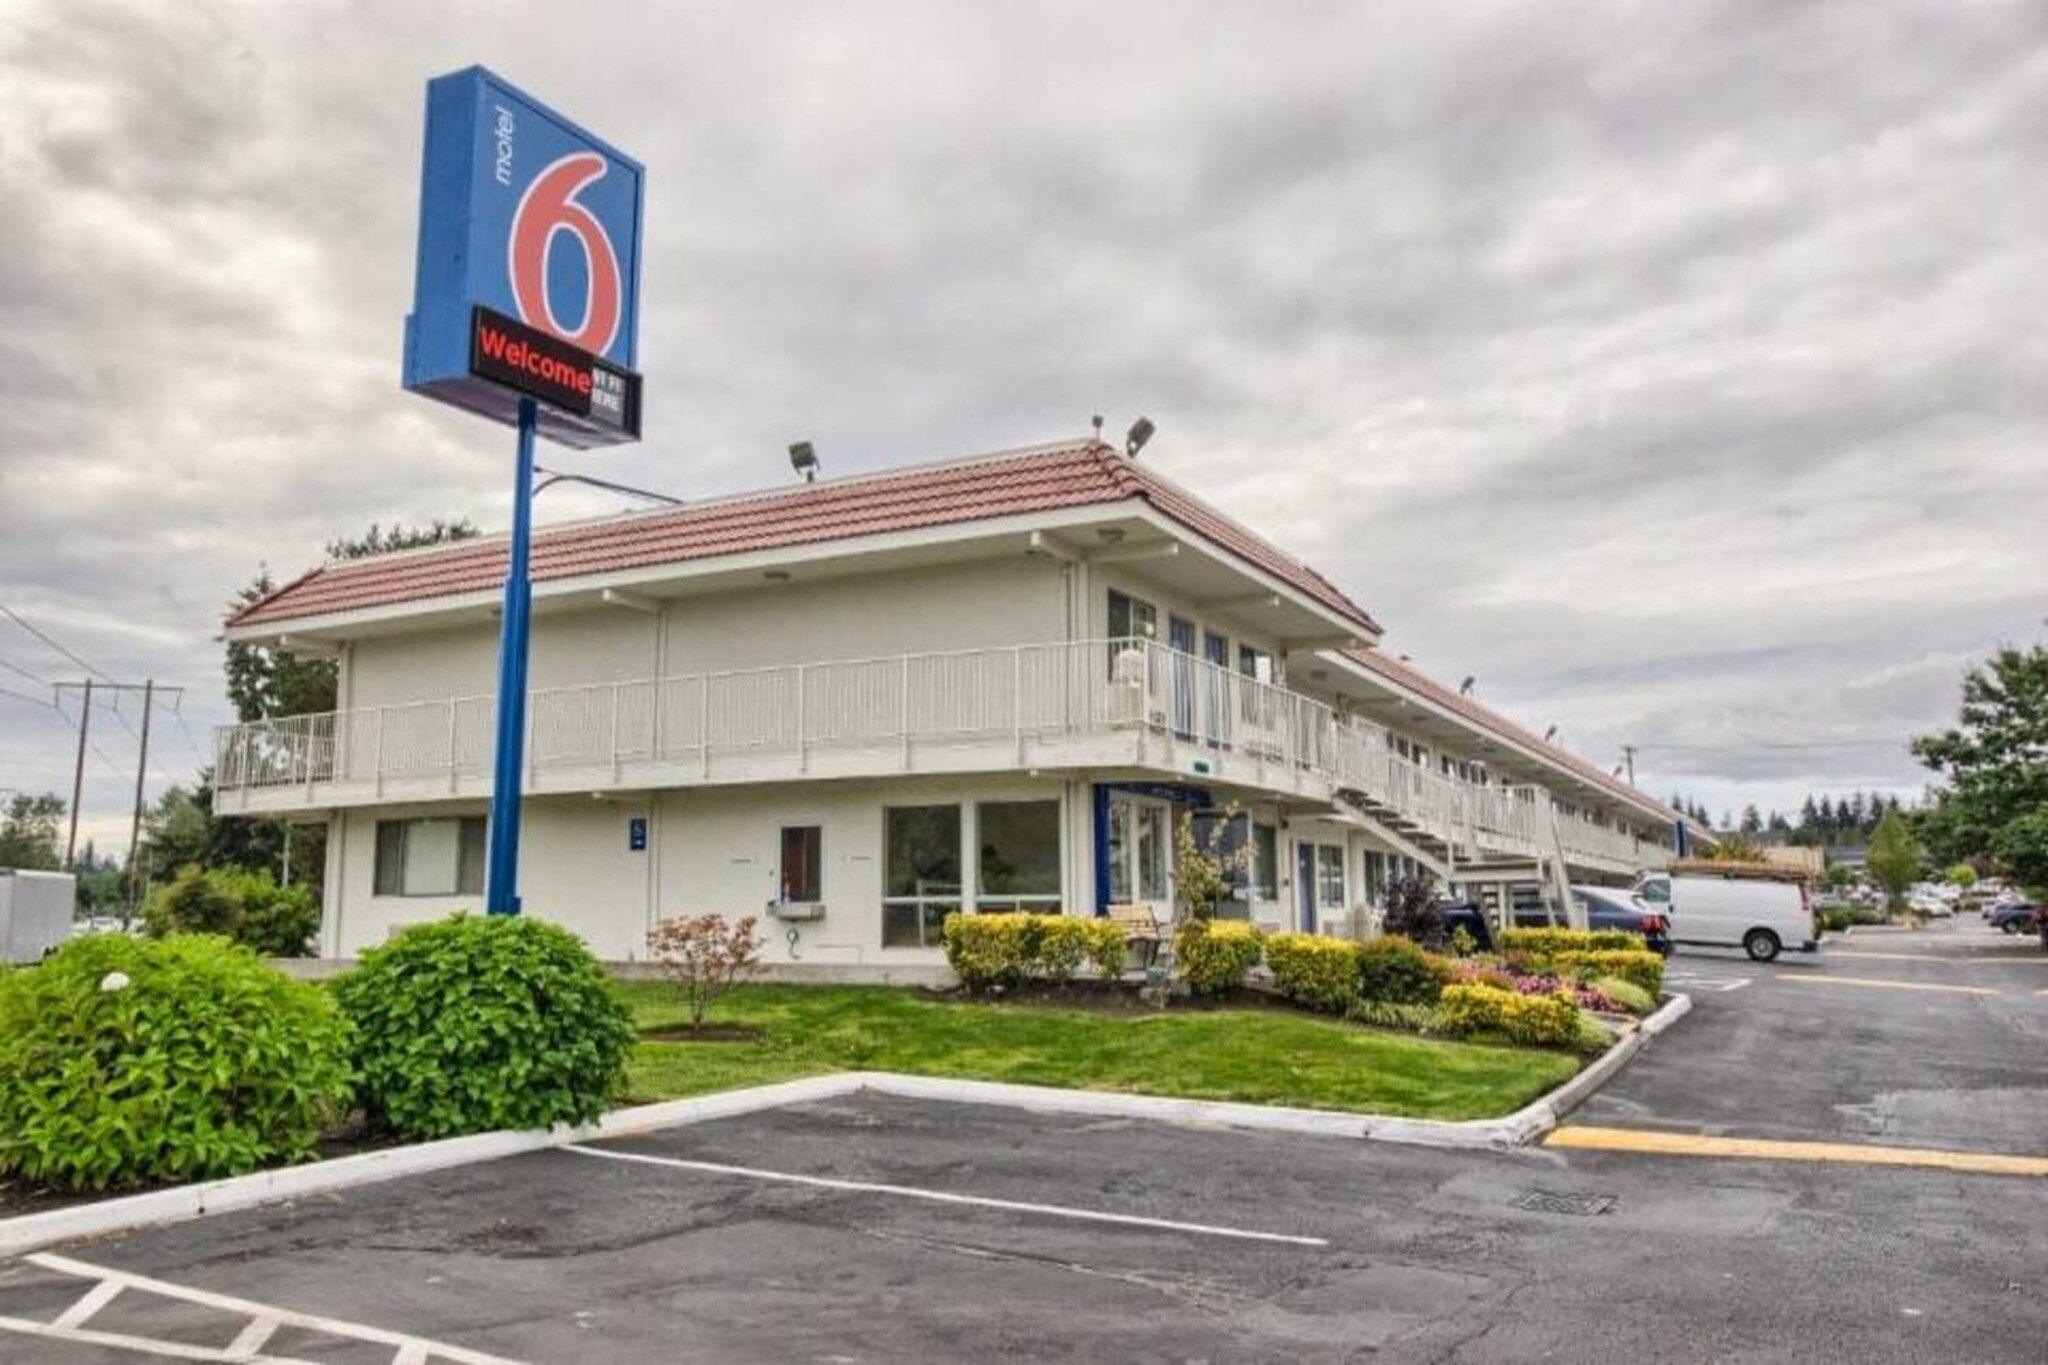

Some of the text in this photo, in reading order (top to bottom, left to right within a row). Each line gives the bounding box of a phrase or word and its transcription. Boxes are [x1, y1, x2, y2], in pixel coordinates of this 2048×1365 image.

[494, 105, 513, 186] motel
[509, 152, 622, 356] 6
[481, 326, 592, 394] Welcome
